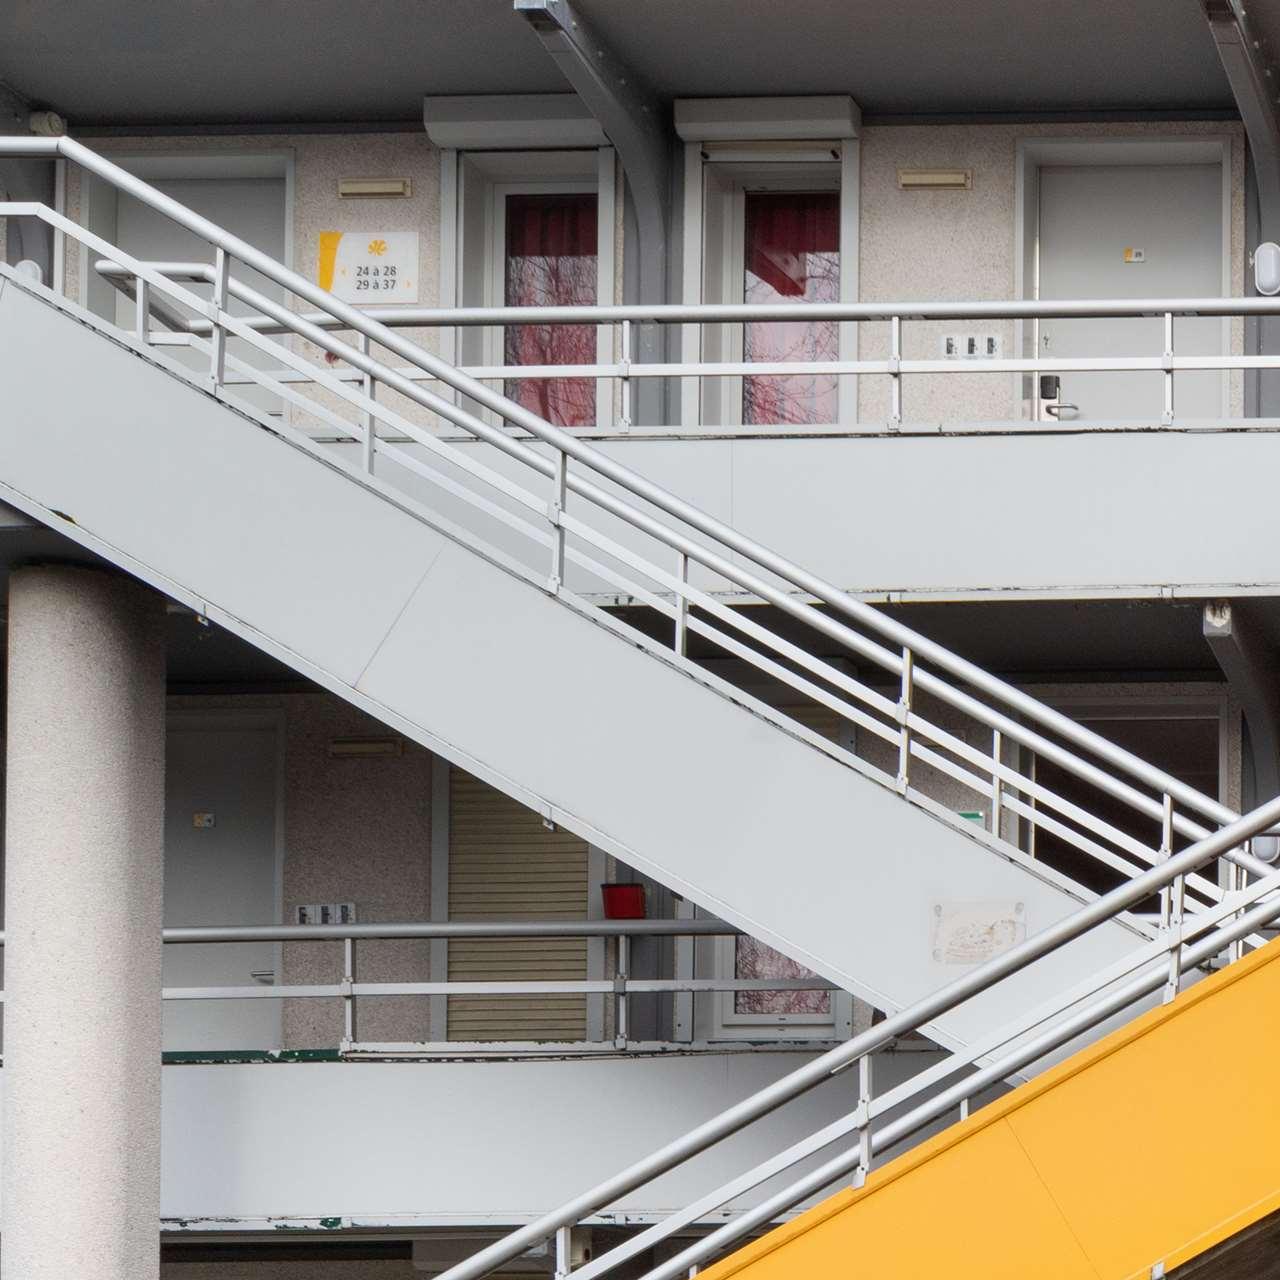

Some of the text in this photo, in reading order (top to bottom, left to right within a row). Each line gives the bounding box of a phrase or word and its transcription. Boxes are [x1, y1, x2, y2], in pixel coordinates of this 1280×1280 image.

[356, 265, 397, 277] 24 à 28
[356, 279, 396, 290] 29 à 37
